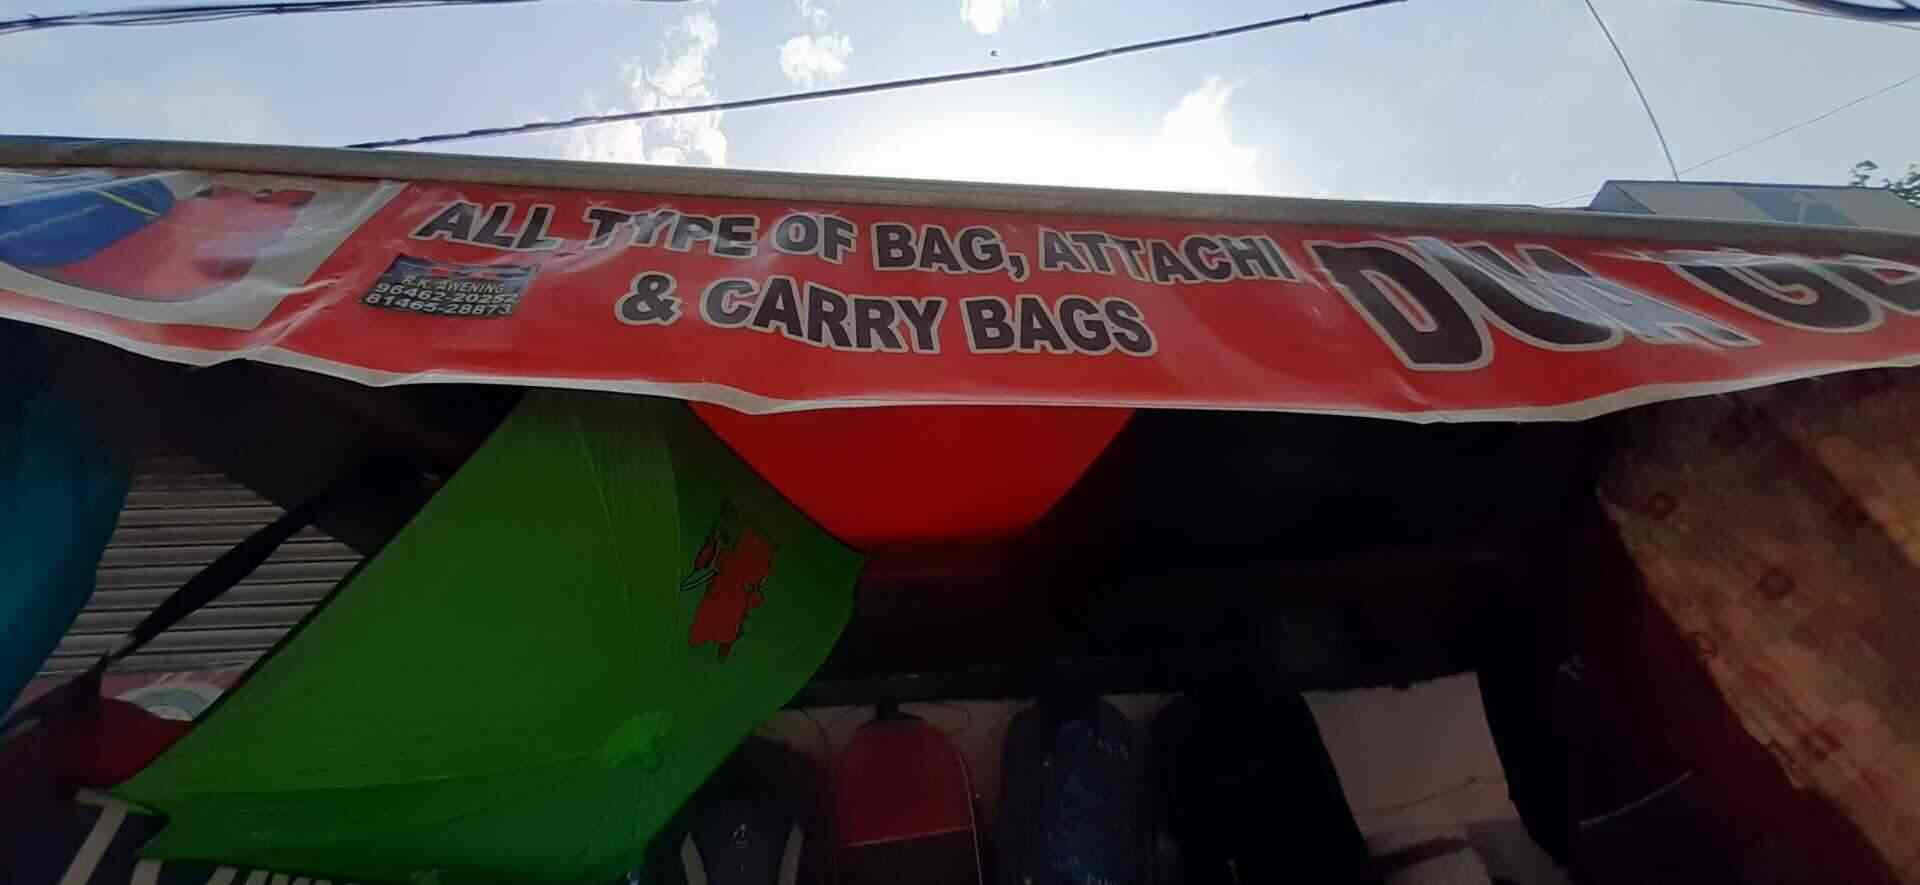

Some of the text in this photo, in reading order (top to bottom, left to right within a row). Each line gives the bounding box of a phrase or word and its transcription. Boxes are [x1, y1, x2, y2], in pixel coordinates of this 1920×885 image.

[411, 200, 1299, 284] ALL TYPE OF BAG, ATTACHI
[366, 293, 513, 316] 81465-28873
[615, 270, 1158, 358] & CARRY BAGS
